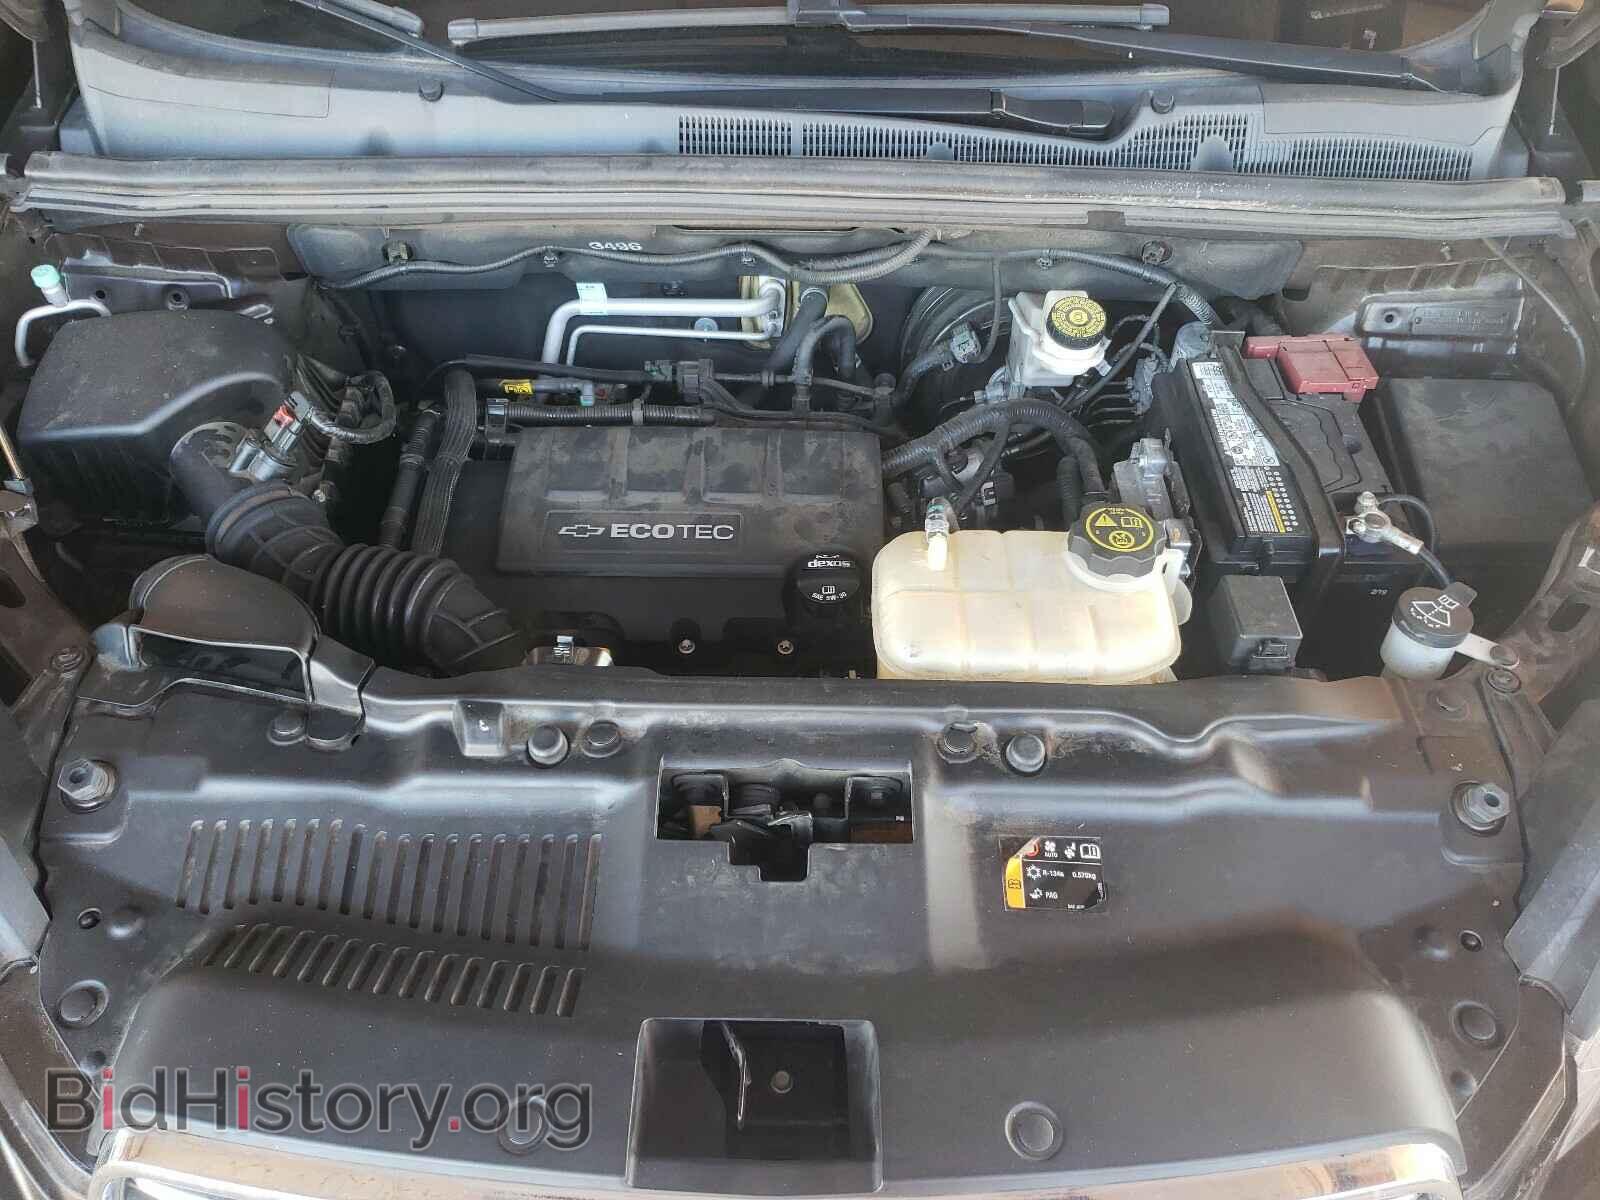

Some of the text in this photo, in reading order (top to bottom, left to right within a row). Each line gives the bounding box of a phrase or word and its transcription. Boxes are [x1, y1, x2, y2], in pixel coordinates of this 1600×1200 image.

[588, 241, 643, 251] 3496
[611, 523, 735, 540] ECOTEC
[807, 559, 852, 568] dexos
